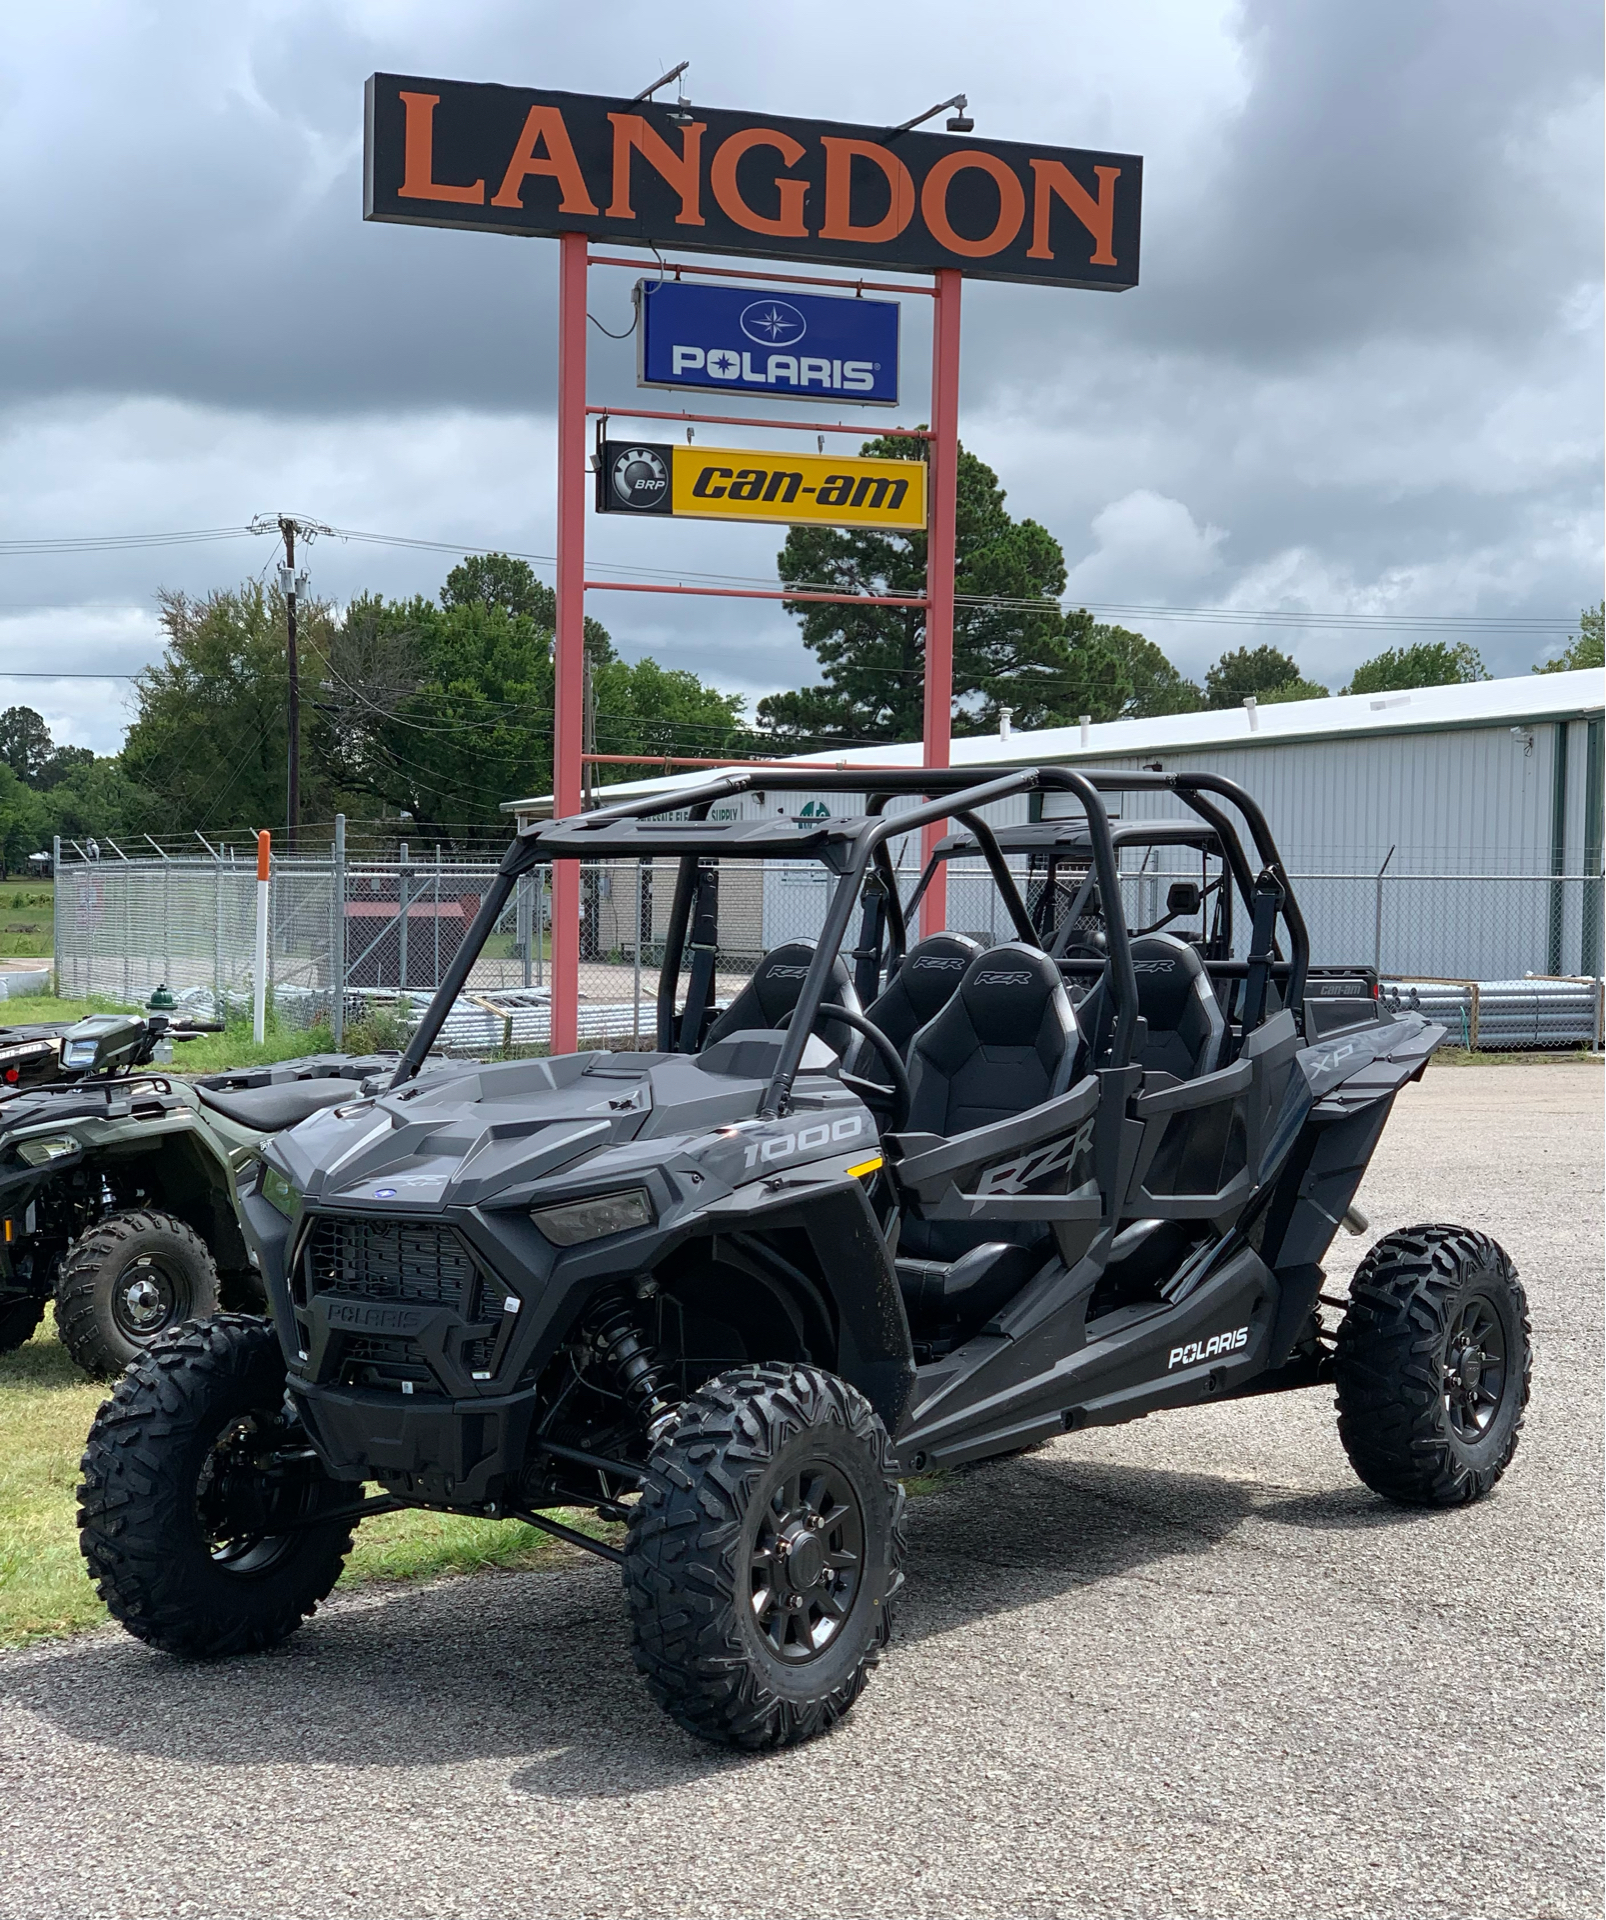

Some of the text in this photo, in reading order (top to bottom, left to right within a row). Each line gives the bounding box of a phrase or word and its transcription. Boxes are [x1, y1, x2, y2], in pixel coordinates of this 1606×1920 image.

[398, 91, 1121, 267] LANGDON
[634, 479, 665, 491] BRP
[692, 466, 909, 510] can-am
[711, 808, 738, 821] SUPPLY
[912, 956, 965, 970] RZR
[1131, 959, 1175, 973] ZR
[973, 971, 1033, 985] RZR
[1320, 985, 1361, 995] can-am
[0, 1044, 42, 1059] an-am
[1309, 1044, 1354, 1080] XP
[744, 1115, 862, 1168] 1000
[970, 1117, 1095, 1217] RZR
[328, 1304, 421, 1328] POLARIS
[1168, 1326, 1249, 1369] POLARIS
